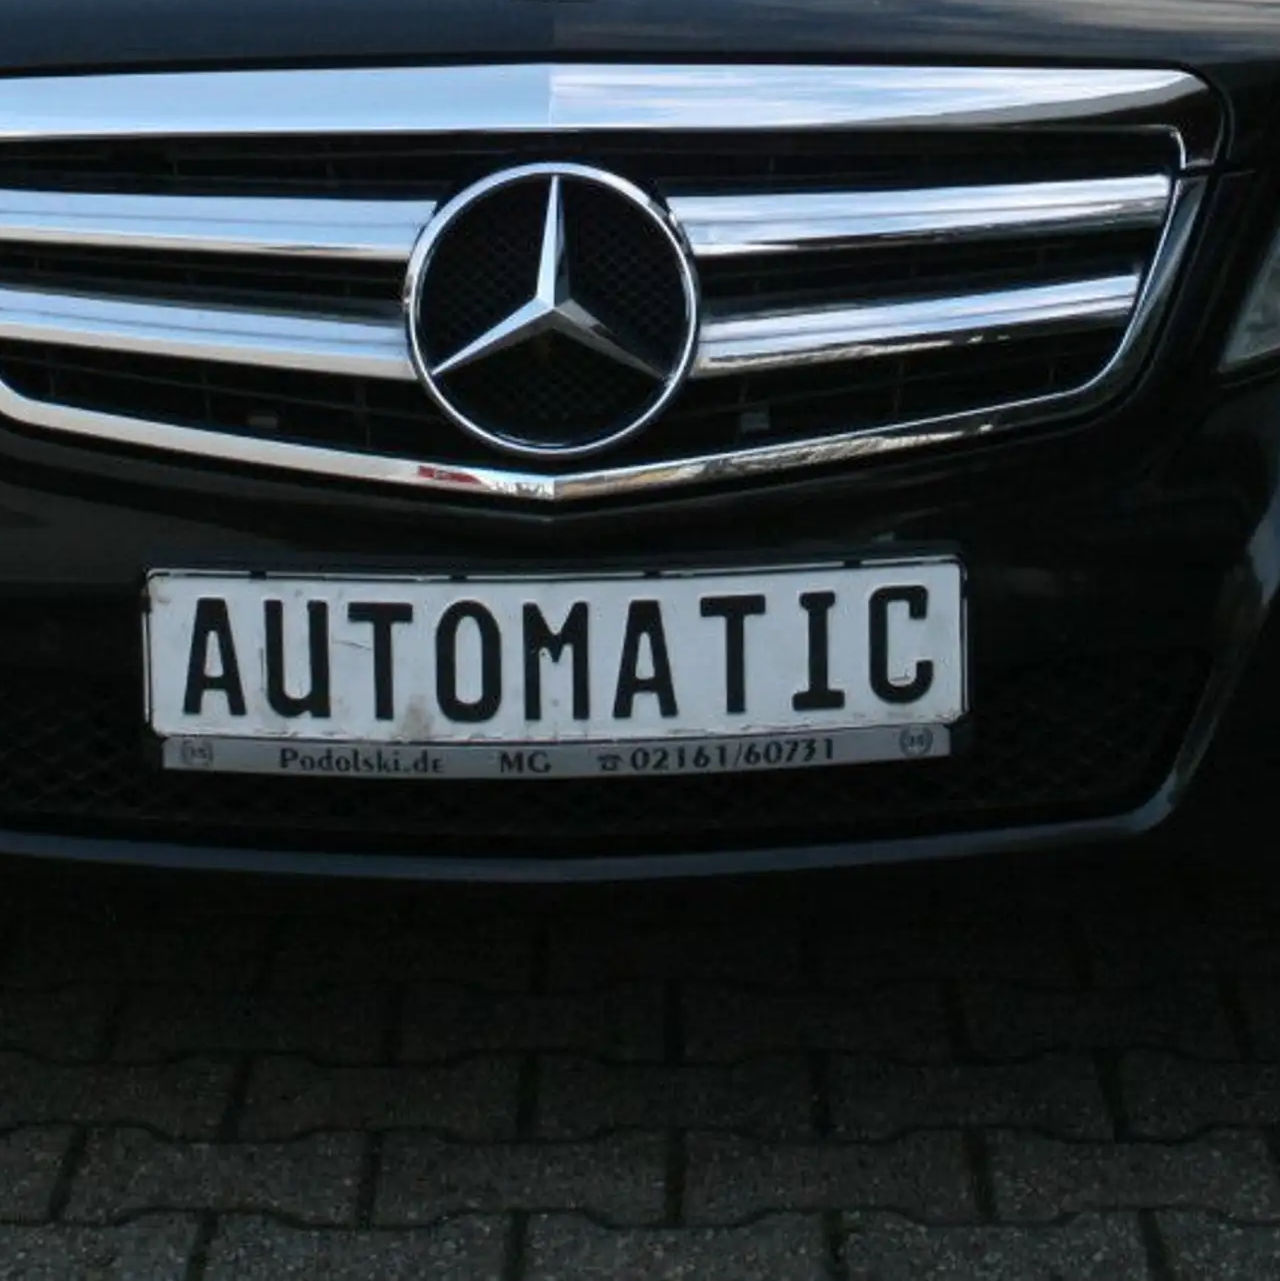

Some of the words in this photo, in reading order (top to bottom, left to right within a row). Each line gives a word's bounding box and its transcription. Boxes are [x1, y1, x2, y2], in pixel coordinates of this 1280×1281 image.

[183, 585, 935, 722] AUTOMATIC
[499, 752, 552, 775] MG
[630, 737, 834, 771] 02161/60731
